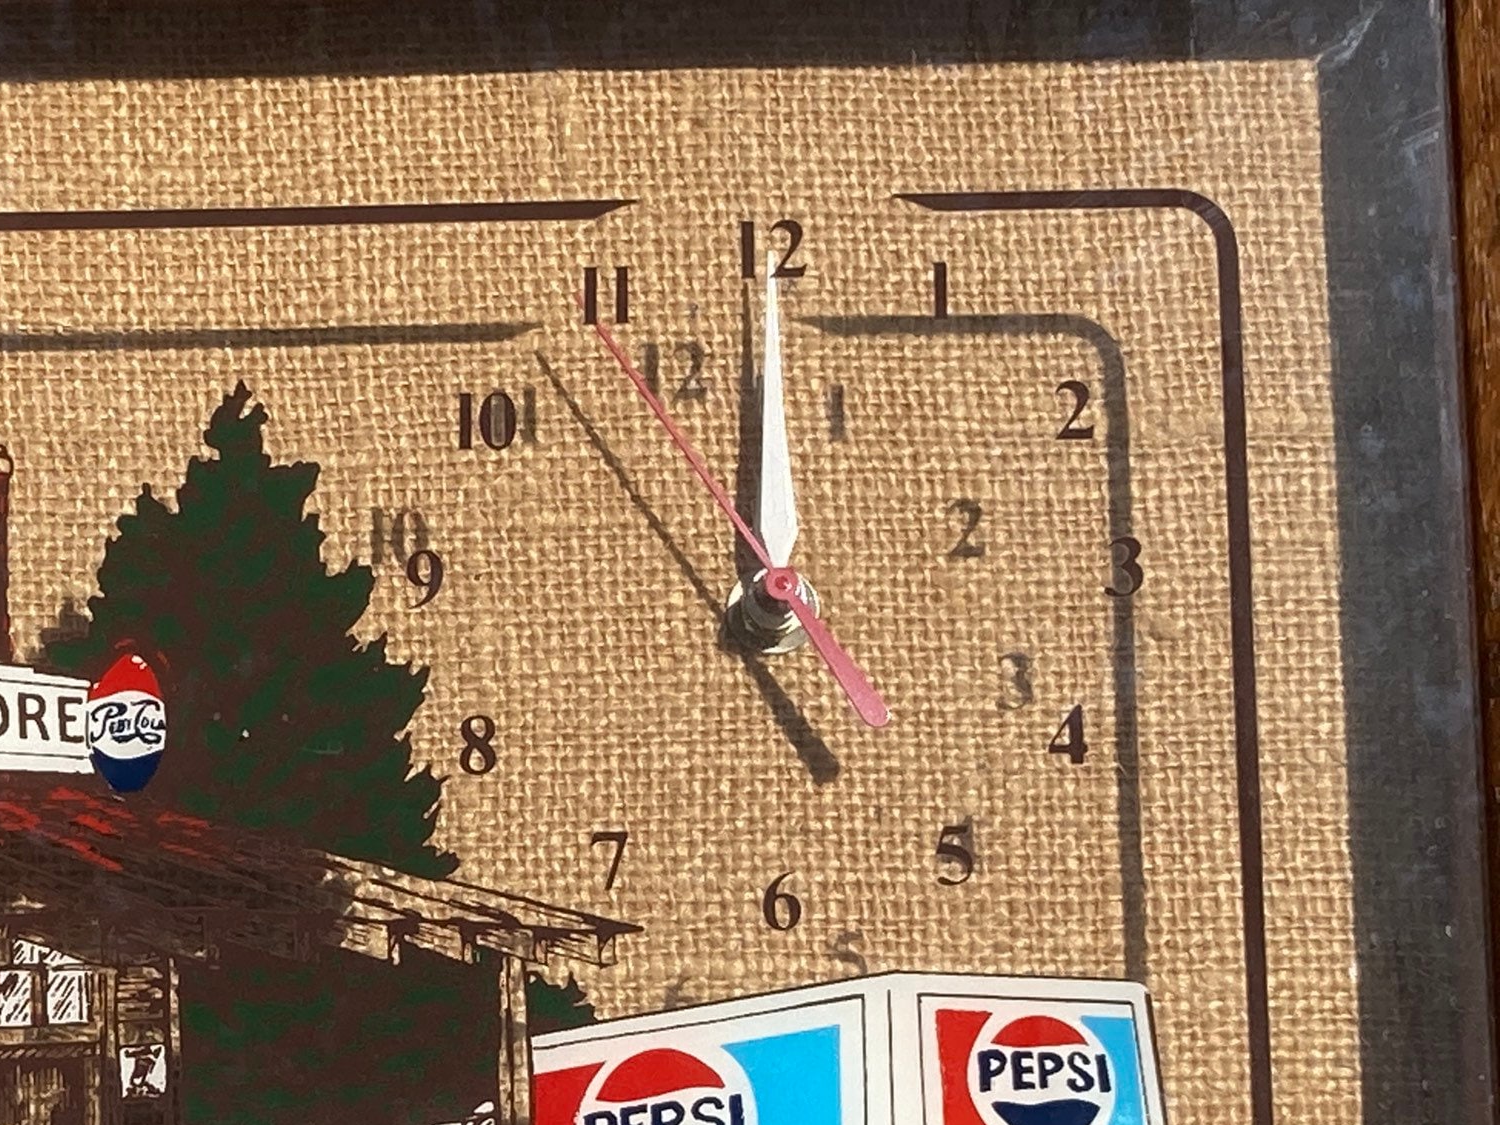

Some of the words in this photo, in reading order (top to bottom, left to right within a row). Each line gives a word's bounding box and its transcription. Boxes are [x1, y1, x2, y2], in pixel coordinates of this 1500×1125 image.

[740, 220, 806, 278] 12
[583, 266, 629, 324] 11
[933, 262, 947, 317] 1
[459, 391, 516, 450] 10
[1055, 380, 1095, 440] 2
[406, 549, 443, 608] 9
[1104, 537, 1143, 596] 3
[459, 715, 497, 775] 8
[1048, 705, 1087, 764] 4
[590, 831, 629, 890] 7
[935, 825, 974, 885] 5
[763, 872, 801, 931] 6
[978, 1049, 1111, 1094] PEPSI
